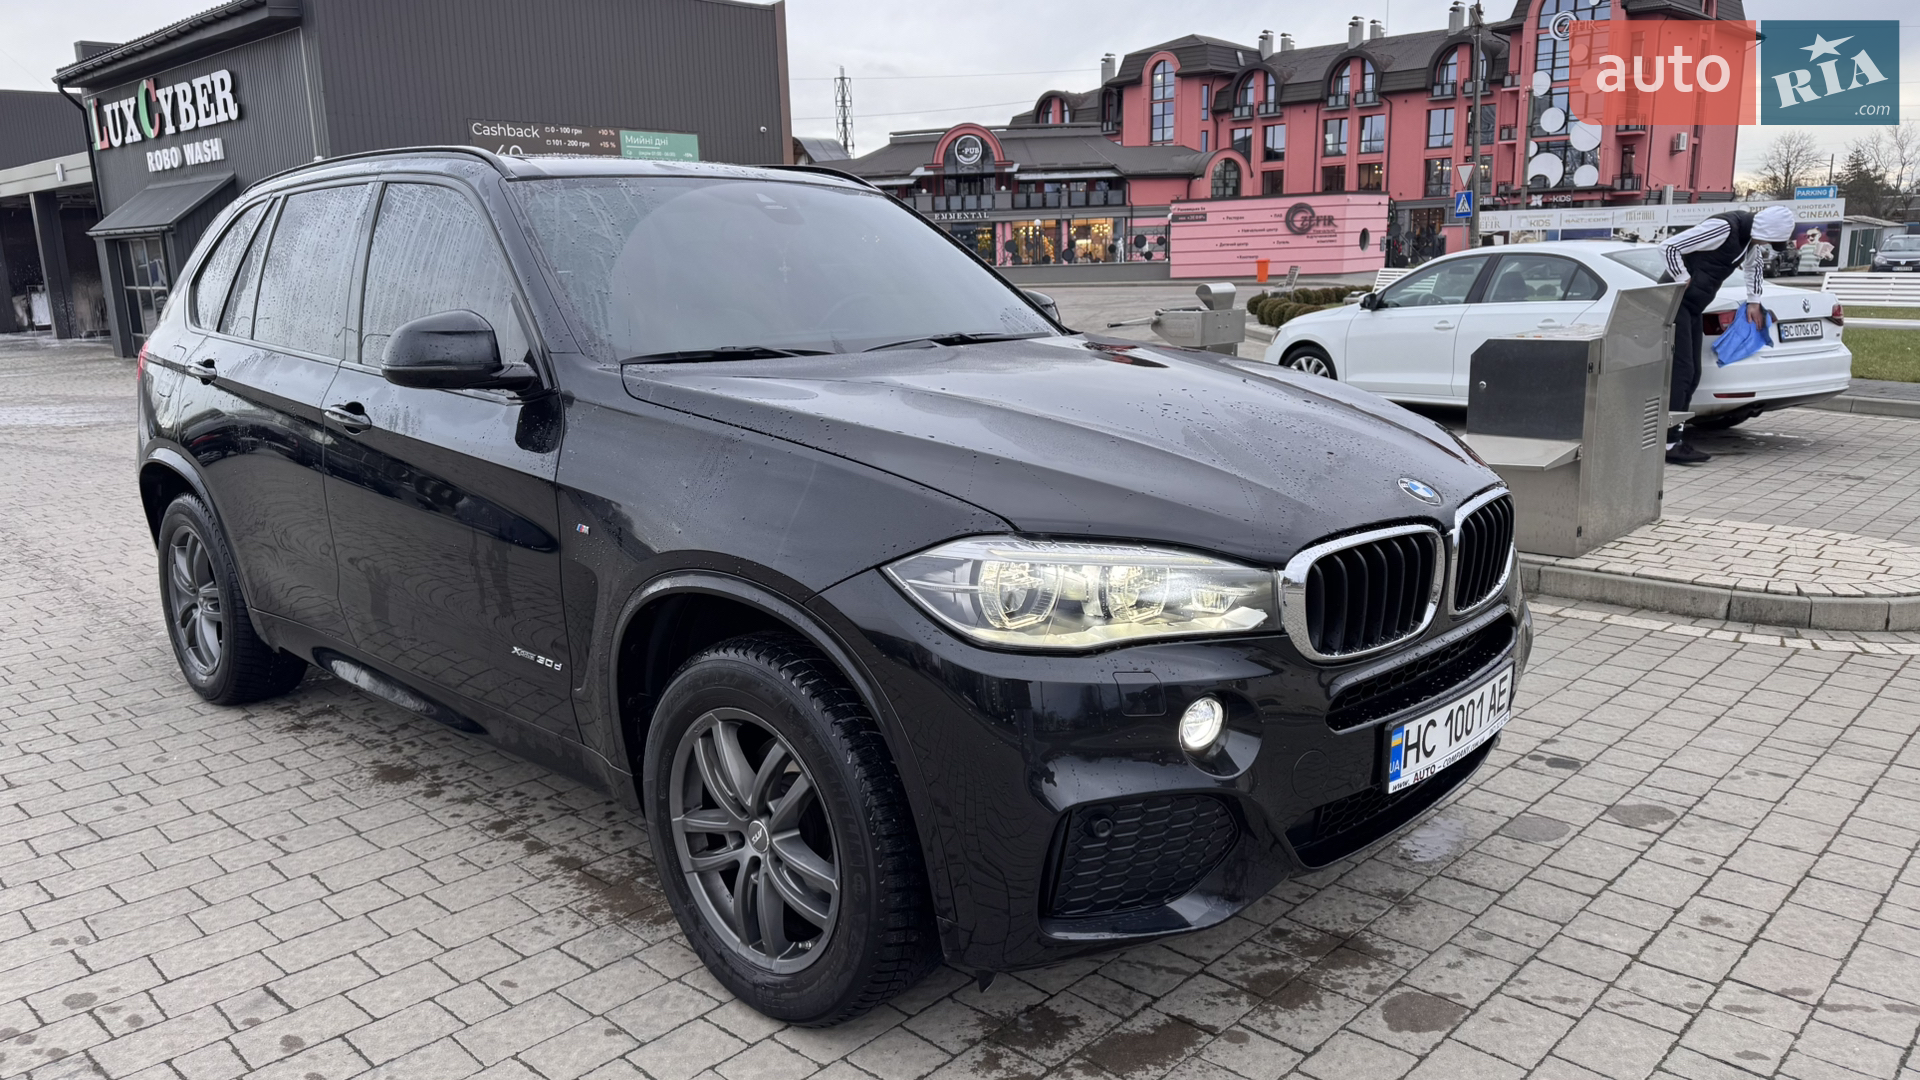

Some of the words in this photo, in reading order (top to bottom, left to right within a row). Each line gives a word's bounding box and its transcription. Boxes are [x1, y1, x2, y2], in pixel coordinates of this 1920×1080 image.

[472, 122, 540, 138] Cashback
[571, 128, 583, 136] грн
[579, 141, 590, 149] грн
[625, 134, 653, 145] Мийні
[654, 136, 669, 147] дні
[146, 146, 182, 172] ROBO
[183, 137, 225, 166] WASH
[1796, 189, 1828, 197] PARKING
[934, 211, 990, 220] EMMENTAL
[1300, 214, 1338, 228] ZEFIR
[1798, 211, 1840, 219] CINEMA
[1479, 220, 1501, 229] EFIR
[1529, 219, 1551, 227] KIDS
[1783, 325, 1795, 337] BC
[1795, 324, 1811, 336] 0706
[1811, 323, 1820, 335] KP
[1402, 719, 1438, 769] HC
[1444, 691, 1485, 748] 1001
[1487, 673, 1508, 723] AE
[1389, 760, 1400, 774] UA
[1413, 764, 1436, 783] AUTO
